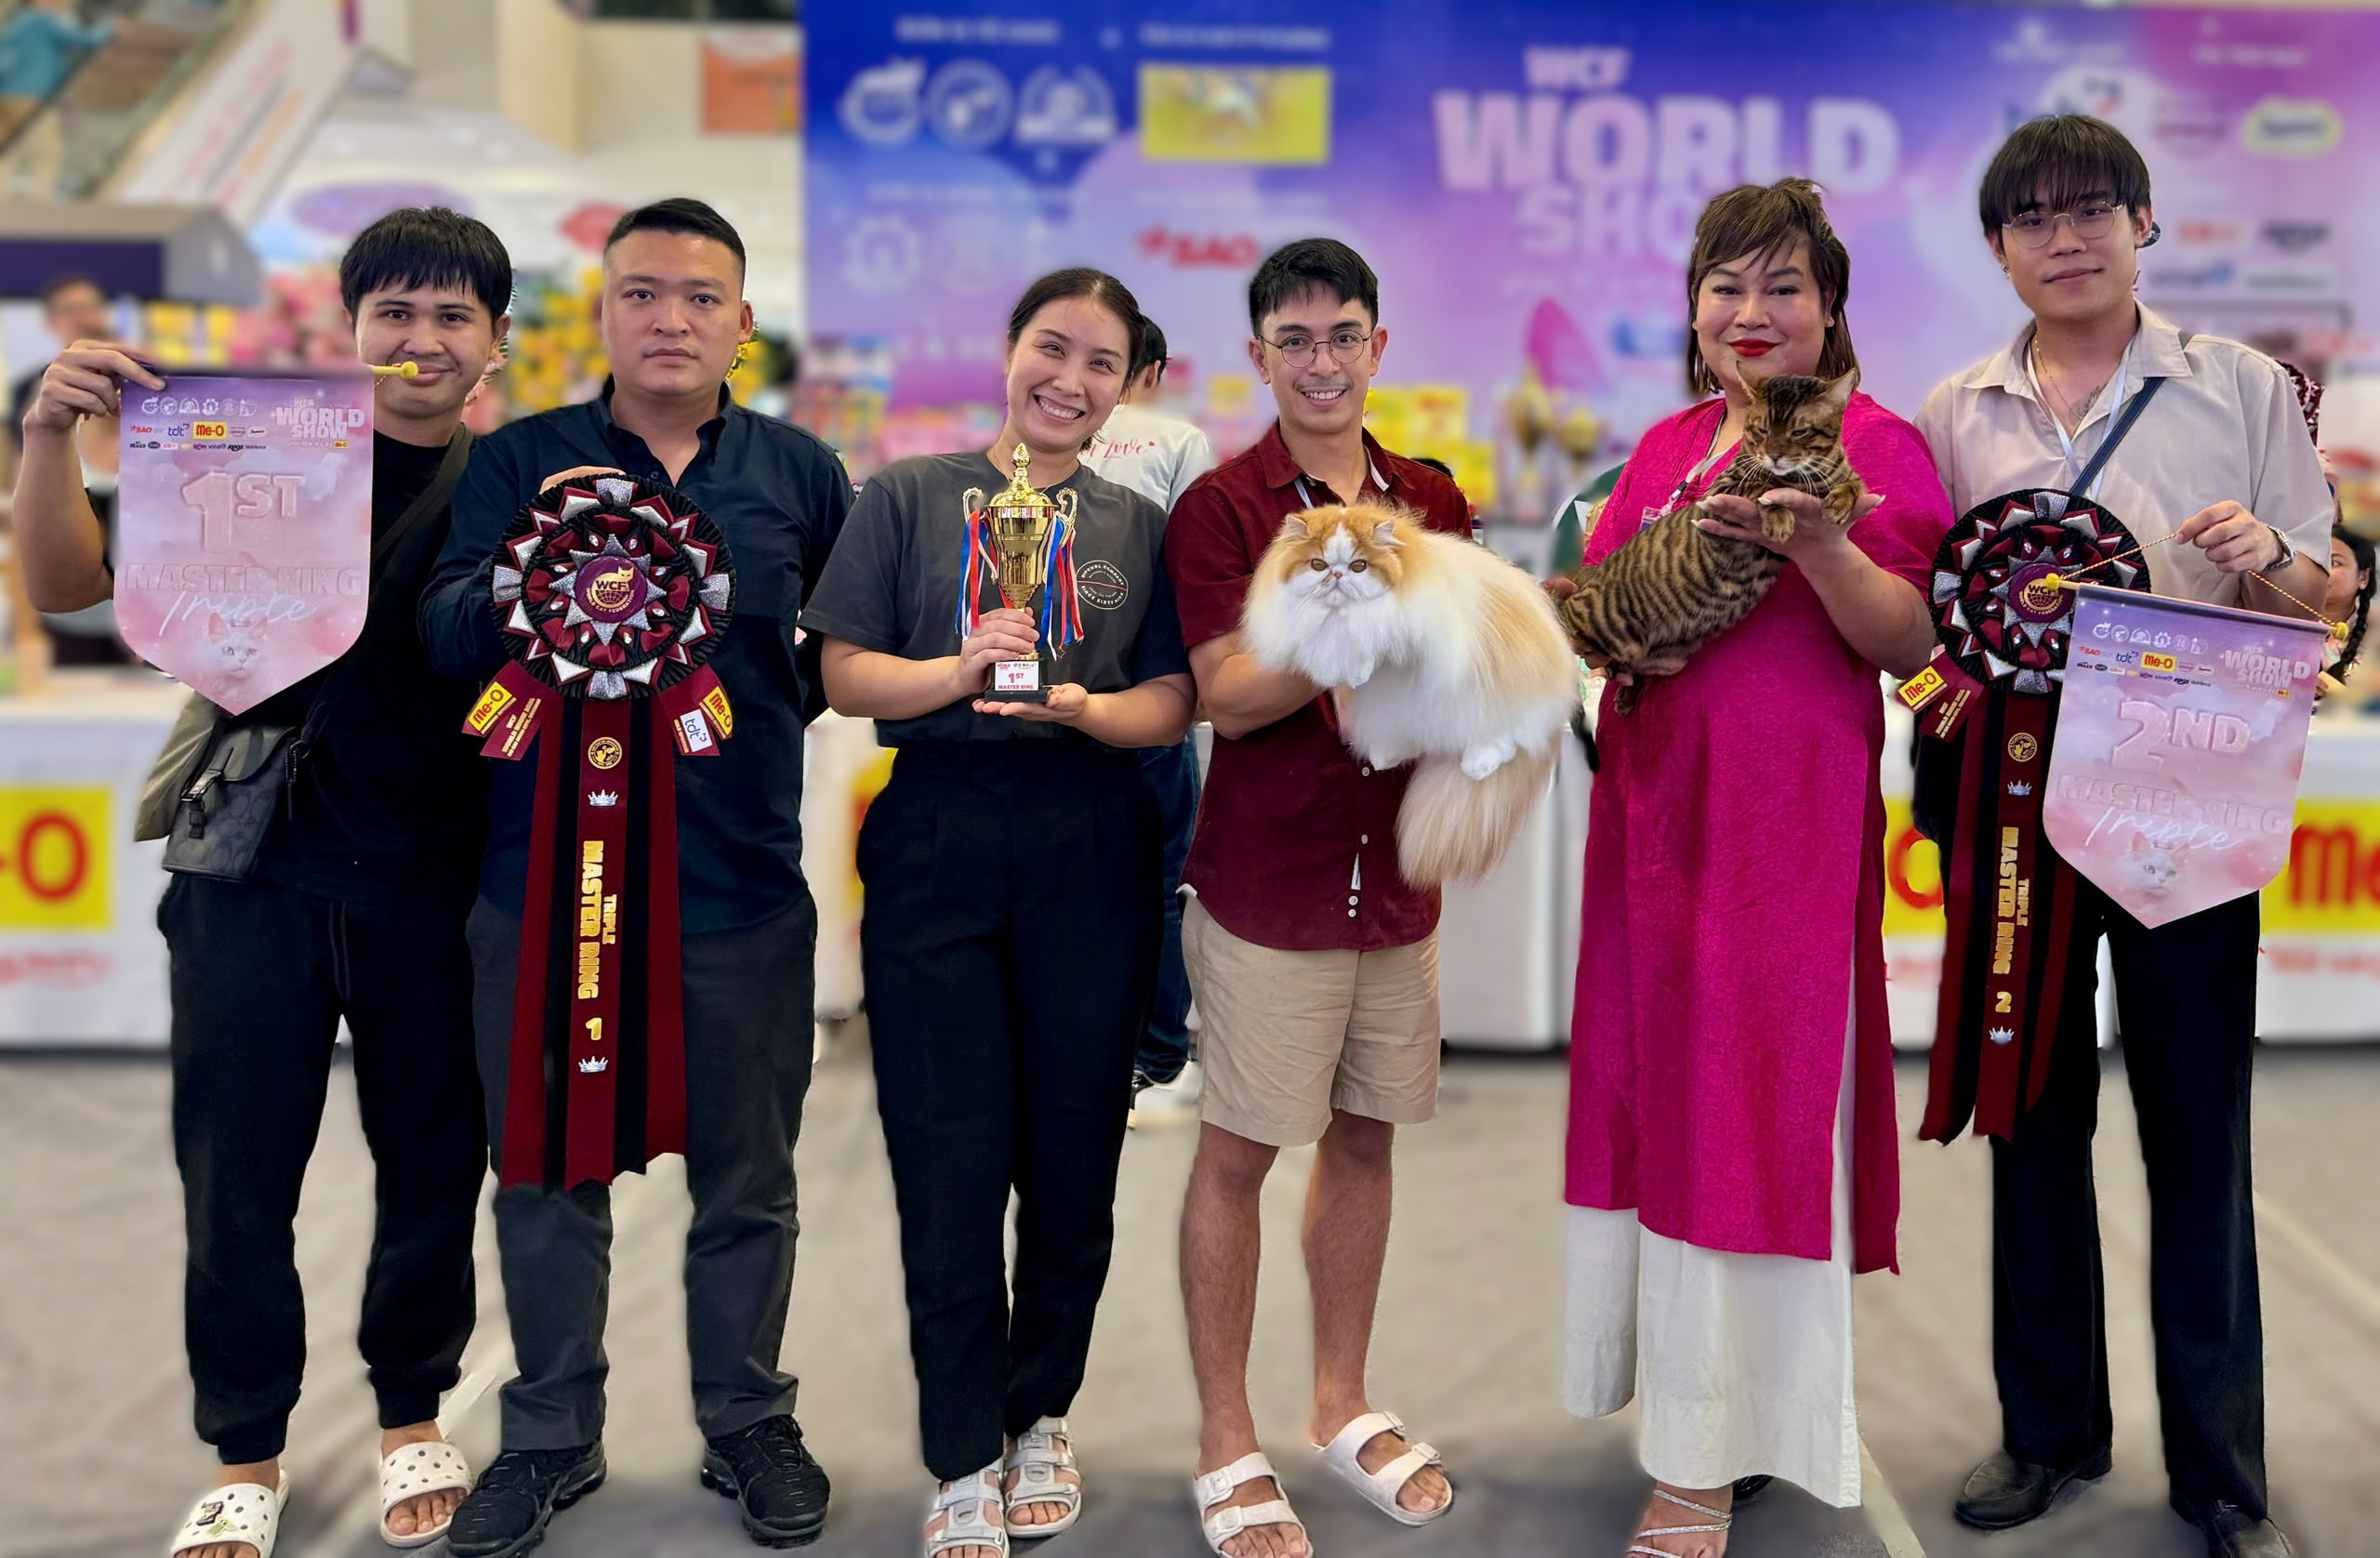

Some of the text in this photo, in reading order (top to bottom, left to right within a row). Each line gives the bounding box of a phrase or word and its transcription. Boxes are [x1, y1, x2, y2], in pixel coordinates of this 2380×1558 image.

[1524, 46, 1632, 88] WCF
[1434, 93, 1900, 195] WORLD
[195, 424, 225, 437] Me-O
[275, 406, 365, 428] WORLD
[291, 421, 348, 440] SHOW
[180, 471, 306, 551] 1ST
[125, 563, 363, 597] MASTER RING
[596, 580, 627, 590] WCF
[2144, 654, 2173, 669] Me-O
[2224, 650, 2311, 680] WORLD
[2237, 668, 2293, 689] SHOW
[1904, 672, 1937, 701] Me-O
[472, 689, 505, 725] Me-O
[708, 693, 732, 728] Me-O
[2110, 700, 2252, 772] 2ND
[2057, 773, 2294, 835] MASTER RING
[602, 893, 617, 944] TRIPLE
[1992, 826, 2019, 1013] MASTER RING 2
[2016, 878, 2030, 927] TRIPLE
[578, 840, 604, 1041] MASTER RING 1
